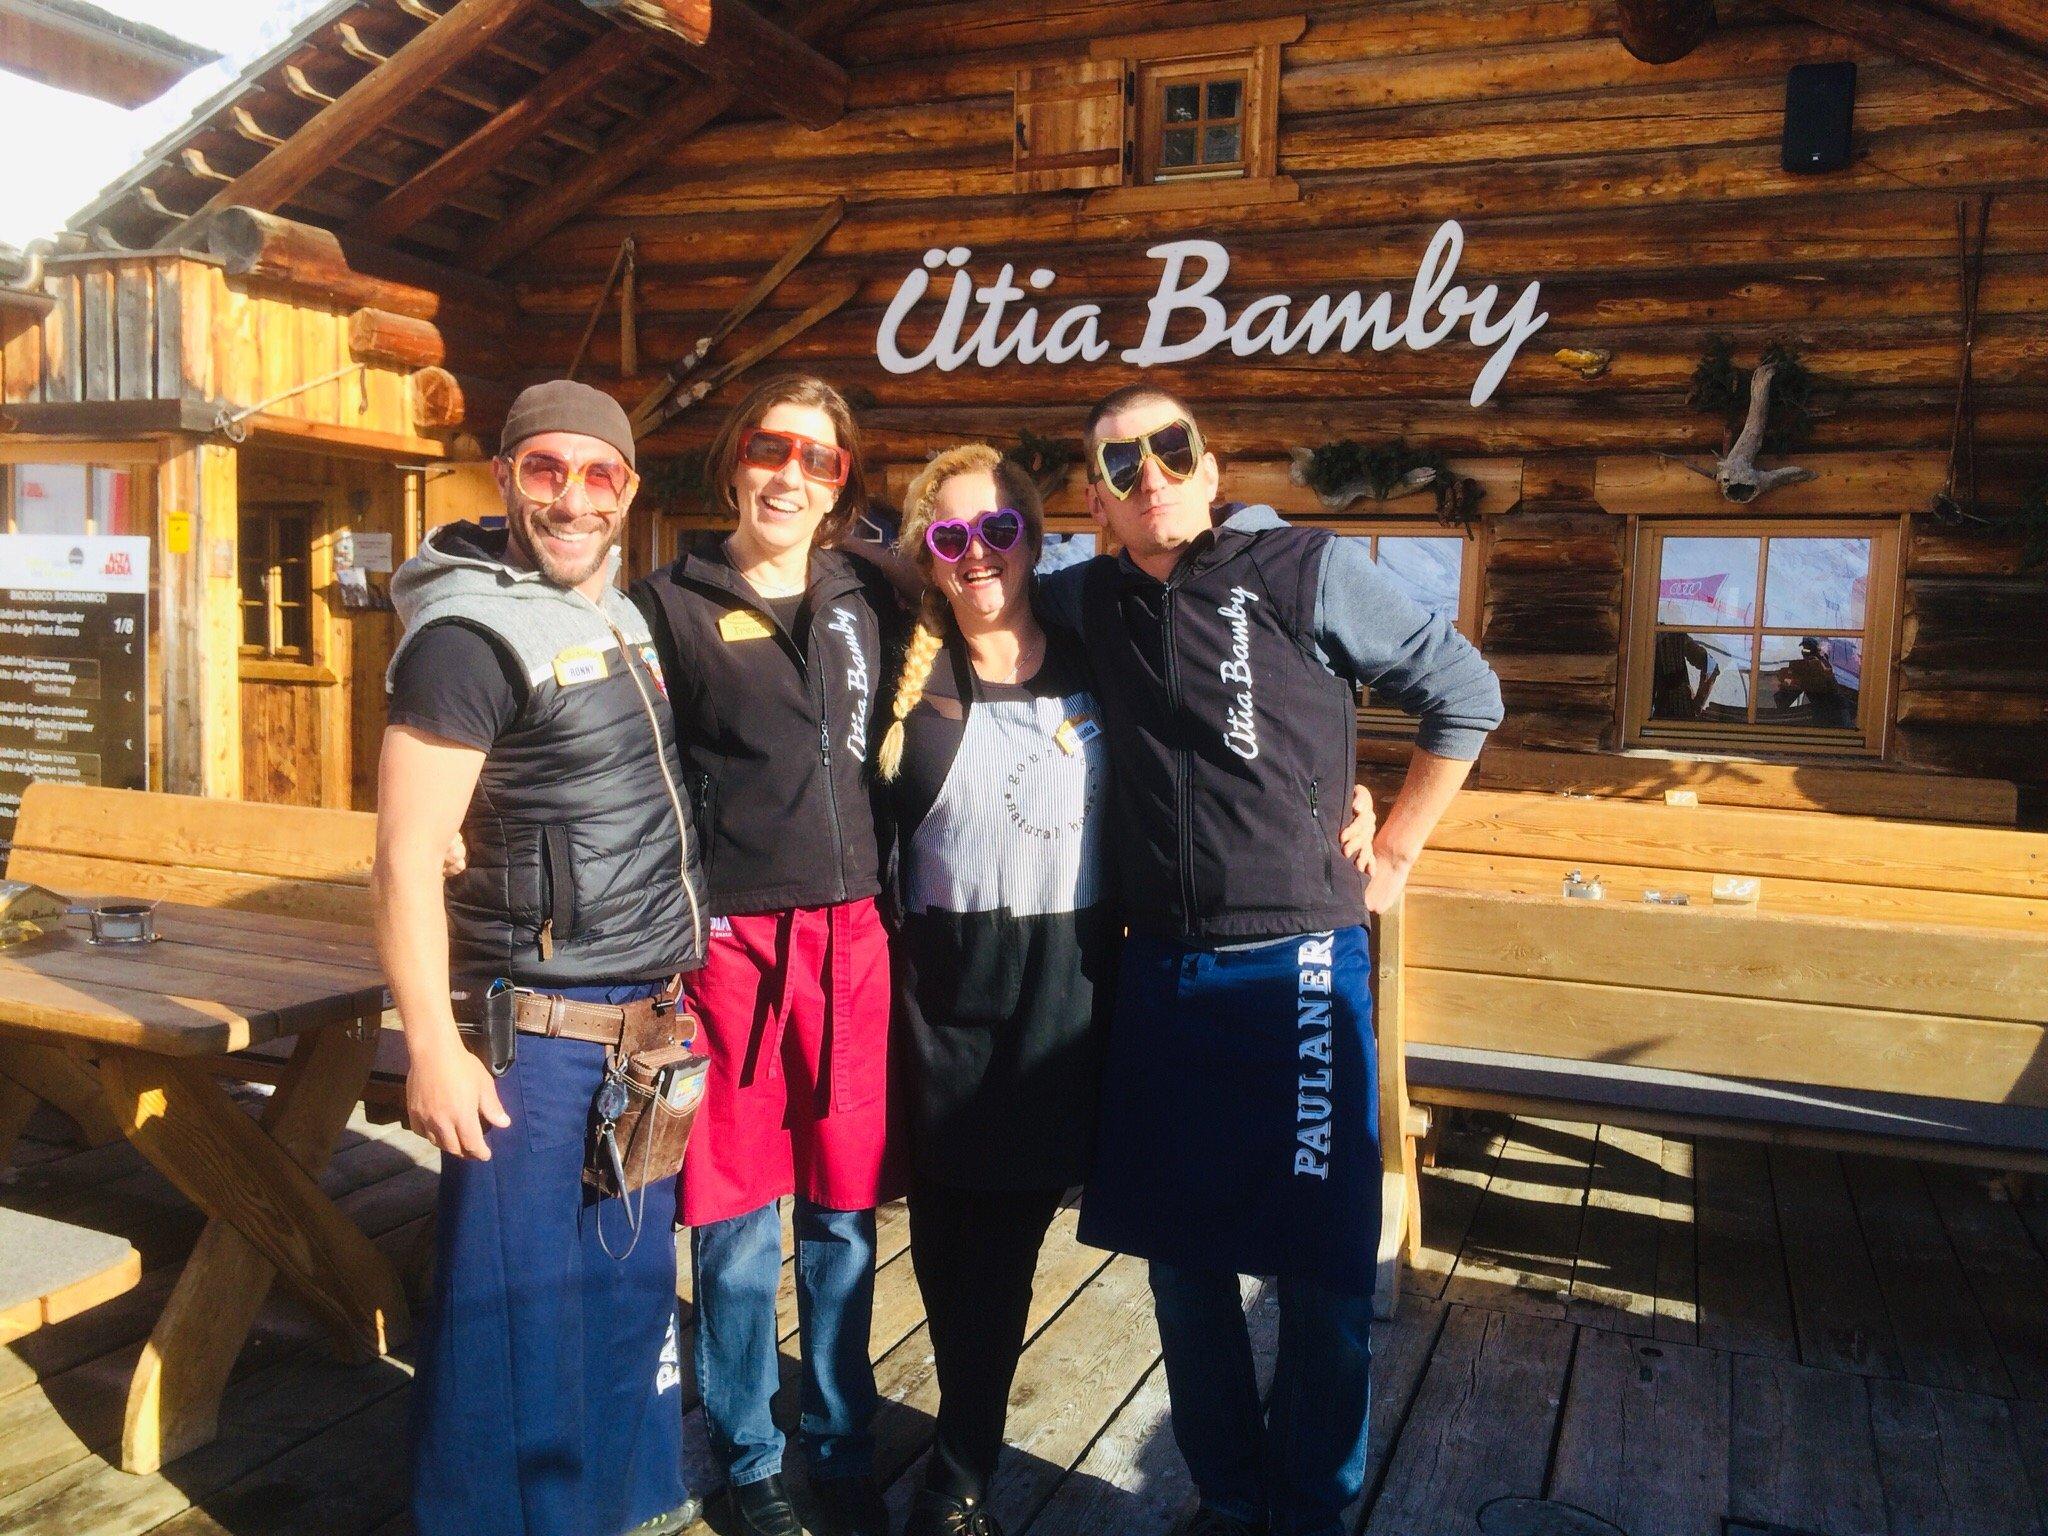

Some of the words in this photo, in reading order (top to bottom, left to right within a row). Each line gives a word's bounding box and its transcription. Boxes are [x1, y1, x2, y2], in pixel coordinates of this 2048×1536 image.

[876, 246, 1110, 374] Ütia
[1121, 219, 1549, 407] Bamby
[104, 563, 132, 575] BADIA
[108, 552, 130, 563] ALTA
[10, 589, 53, 601] BIOLOGICO
[54, 590, 107, 603] BIODINAMICO
[828, 607, 869, 697] Bamby
[1217, 585, 1259, 688] Bamby
[1223, 690, 1259, 760] Ütia
[1007, 803, 1060, 839] natural
[1294, 932, 1334, 1181] PAULANER
